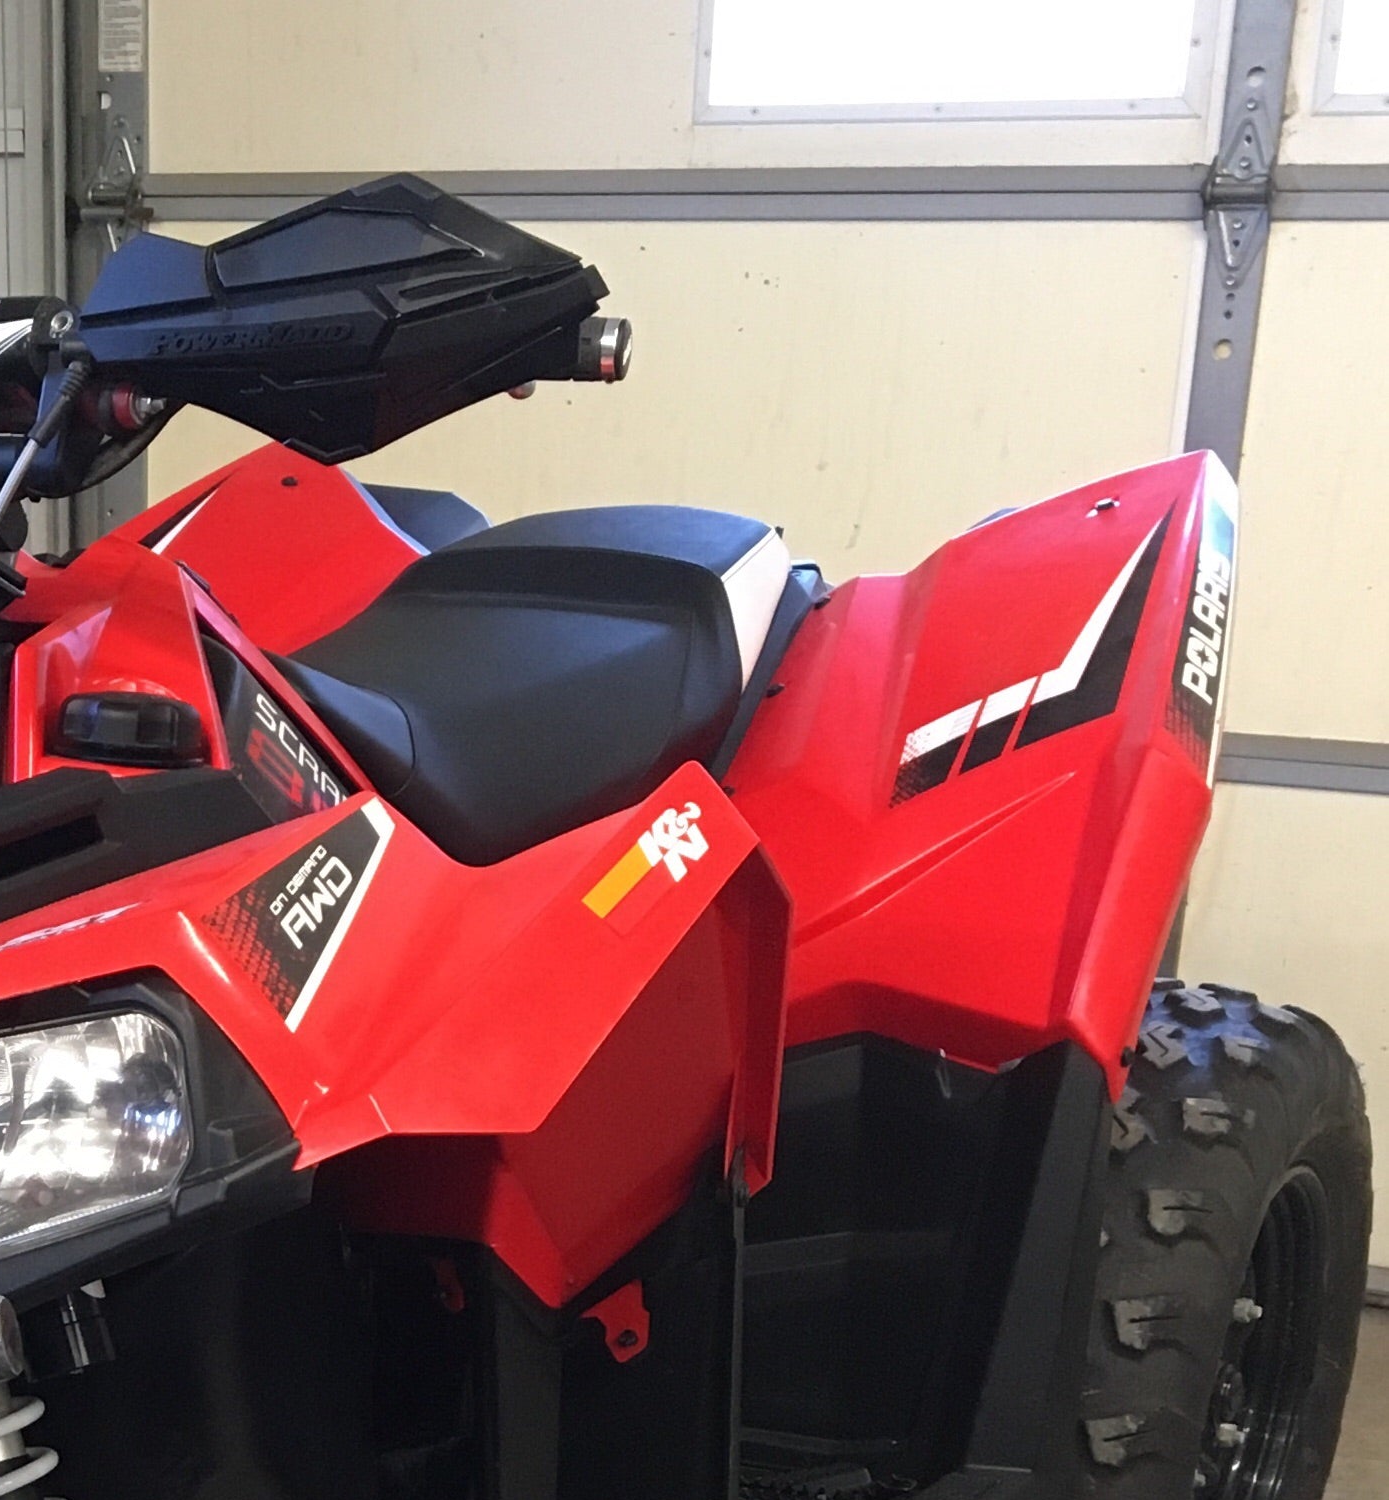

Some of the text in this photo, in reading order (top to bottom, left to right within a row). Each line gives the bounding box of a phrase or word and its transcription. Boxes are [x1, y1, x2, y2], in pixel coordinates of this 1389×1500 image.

[1181, 552, 1231, 705] POLARIS
[255, 693, 348, 807] SCRA
[637, 801, 709, 883] K&N
[280, 856, 352, 950] AWD
